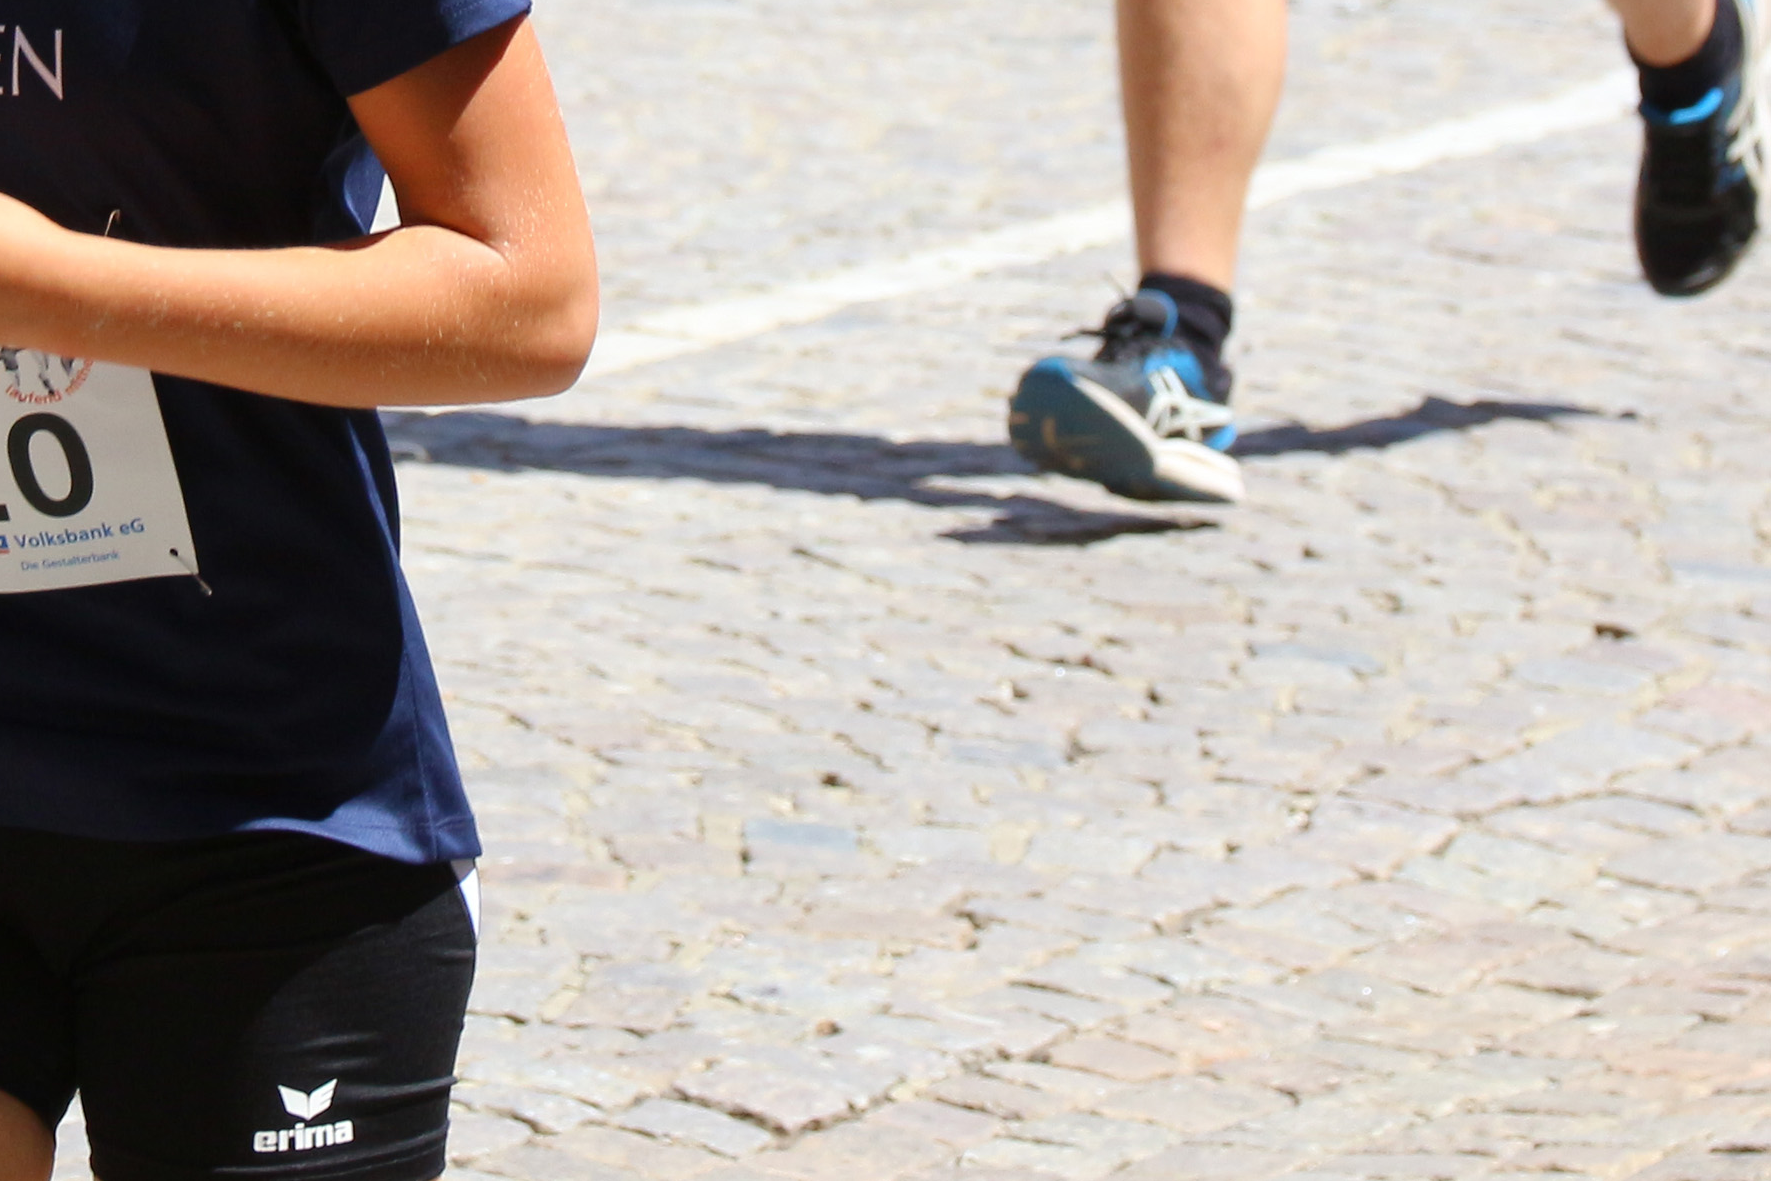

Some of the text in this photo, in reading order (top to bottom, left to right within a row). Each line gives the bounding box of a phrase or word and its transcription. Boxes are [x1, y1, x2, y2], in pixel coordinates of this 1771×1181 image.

[13, 517, 146, 549] Volksbank eG
[253, 1119, 355, 1153] erima
